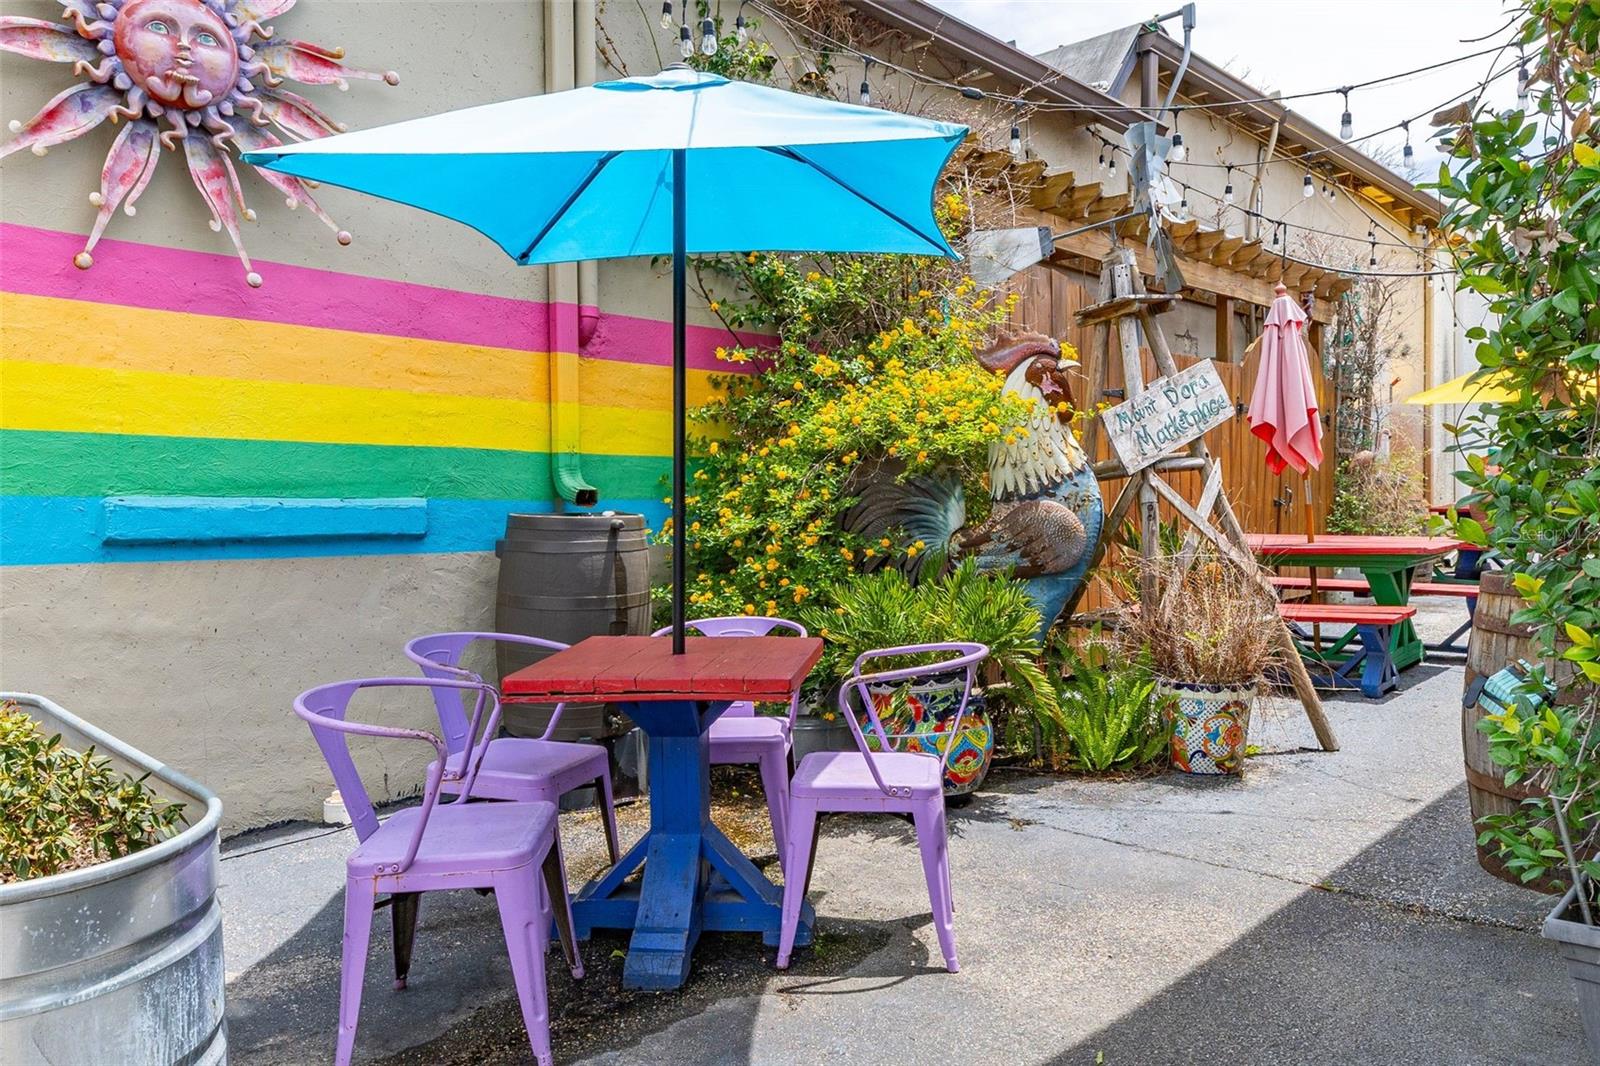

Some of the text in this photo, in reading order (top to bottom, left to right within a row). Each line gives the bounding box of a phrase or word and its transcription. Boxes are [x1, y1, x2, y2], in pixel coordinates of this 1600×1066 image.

[1116, 374, 1210, 432] Mount Dora
[1135, 394, 1227, 456] Marketplace
